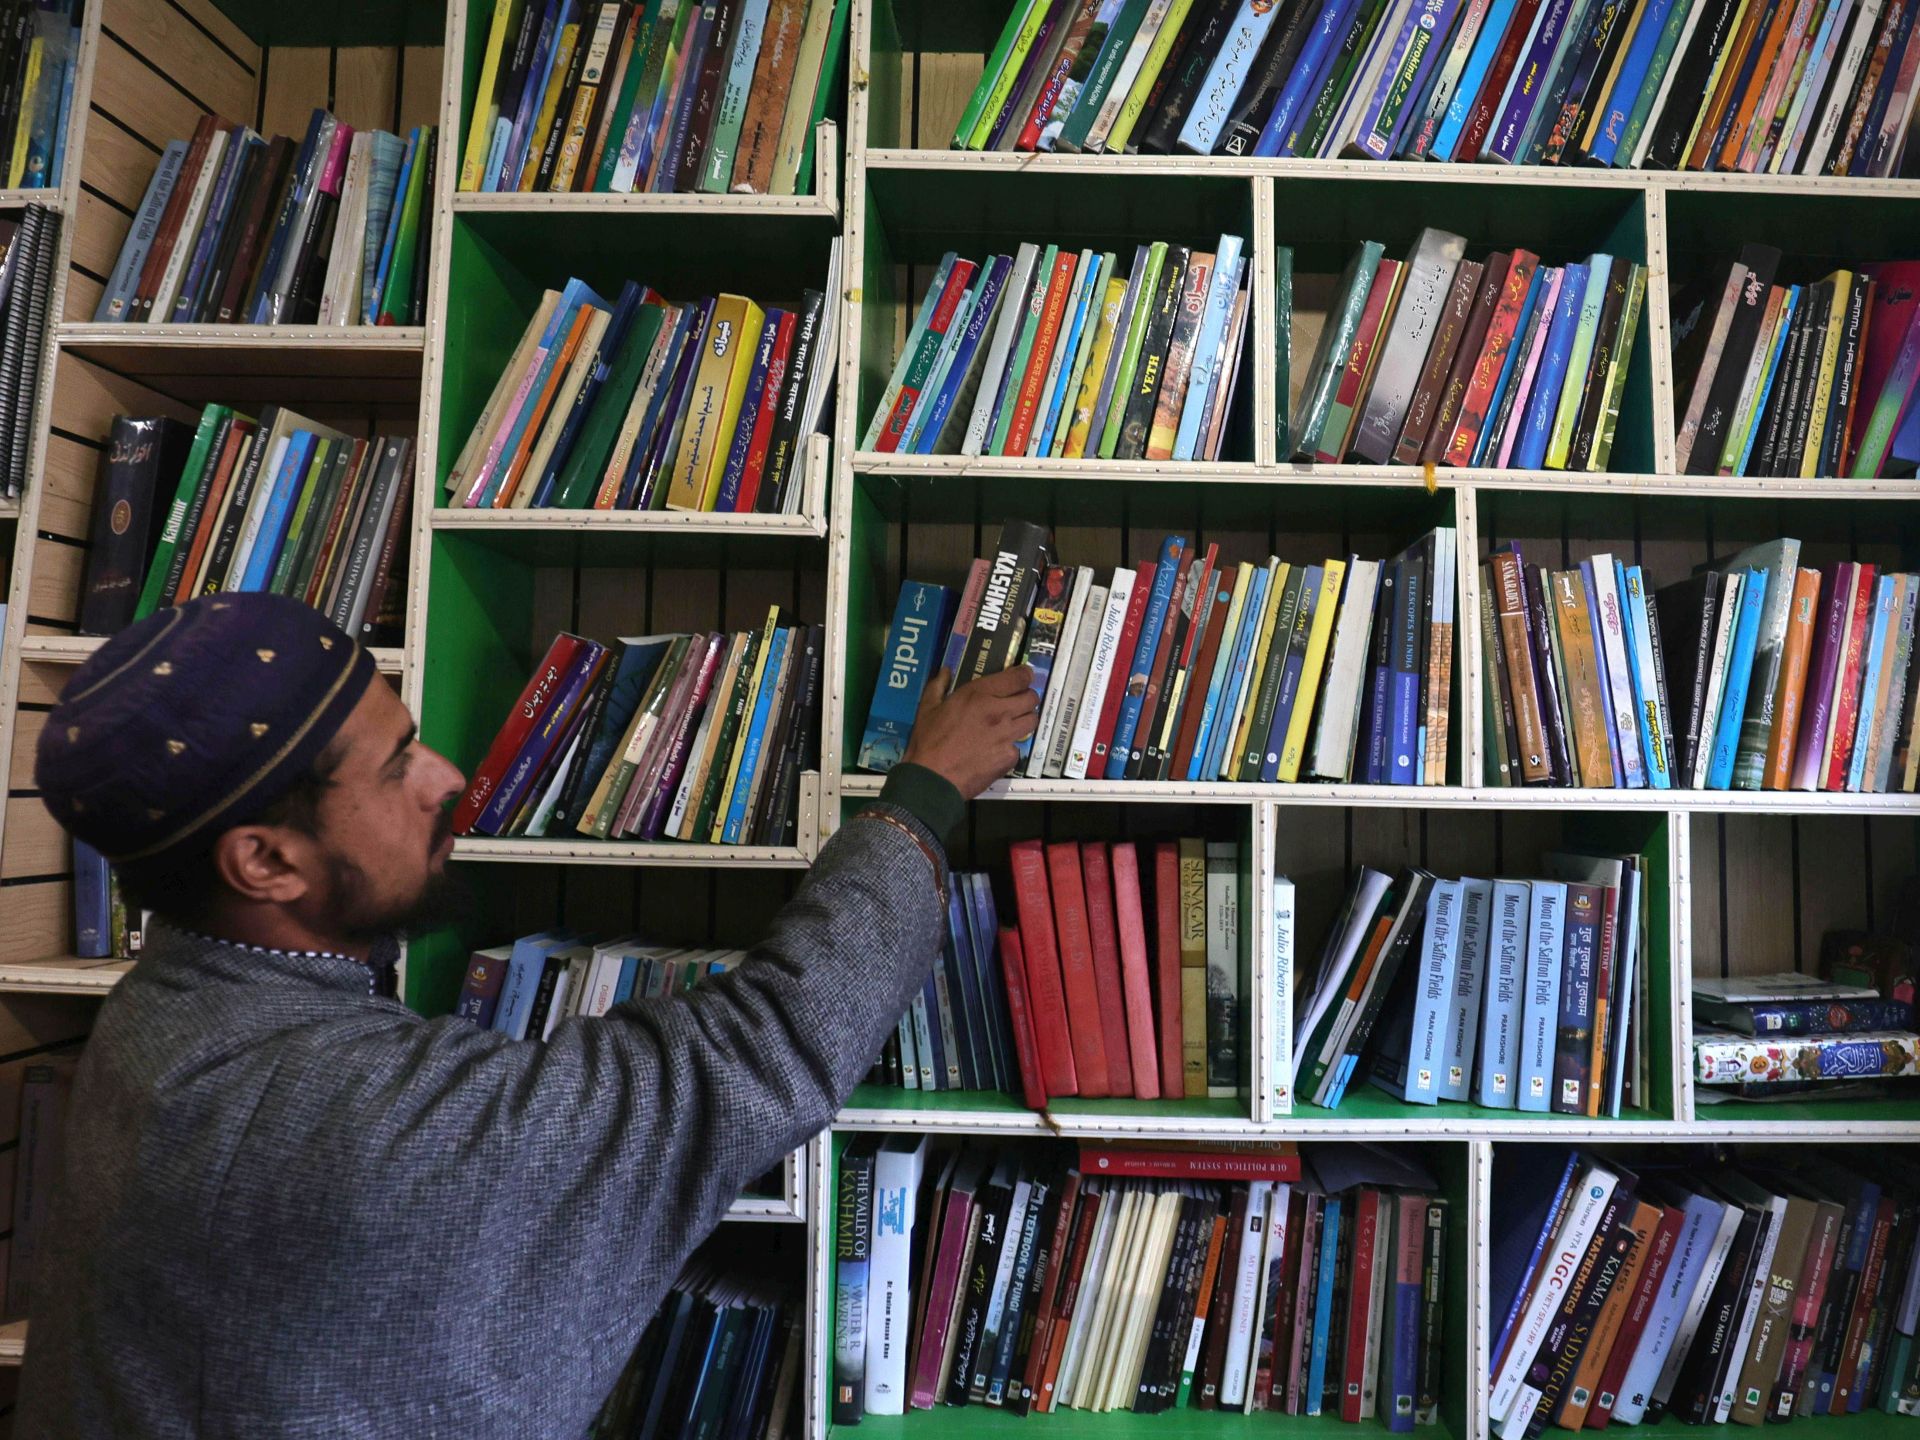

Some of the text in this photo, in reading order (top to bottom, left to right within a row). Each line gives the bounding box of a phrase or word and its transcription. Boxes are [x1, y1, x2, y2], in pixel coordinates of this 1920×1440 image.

[1086, 38, 1123, 107] The urdu magazine NAGINA
[1403, 30, 1431, 82] Nurokind
[136, 148, 181, 242] Moon of the Saffron Fields
[1836, 287, 1865, 406] JAMMU KASHMIR
[1139, 353, 1160, 396] VETH
[160, 496, 188, 544] Kashmir
[346, 536, 368, 586] RAILWAYS
[1154, 559, 1176, 599] Azad
[975, 549, 1018, 632] KASHMIR
[1000, 565, 1024, 625] THE VALLEY OF
[1278, 589, 1296, 631] CHINA
[1294, 586, 1313, 632] MIZORAM
[1104, 603, 1122, 633] Julio
[1404, 575, 1417, 668] TELESCOPES IN INDIA
[885, 614, 929, 692] India
[1094, 632, 1114, 673] Ribeiro
[674, 693, 700, 742] Examination
[660, 761, 676, 783] Easy
[667, 739, 683, 763] Made
[1190, 860, 1203, 940] SRINAGAR
[1540, 895, 1556, 920] Moon
[1427, 892, 1452, 999] Moon of the Saffron Fields
[1457, 891, 1482, 997] Moon of the Saffron Fields
[1497, 894, 1519, 1003] Moon of the Saffron Fields
[1538, 931, 1554, 946] the
[1539, 921, 1555, 931] of
[1536, 946, 1553, 978] Saffron
[1601, 946, 1609, 970] STORY
[1534, 979, 1551, 1006] Fields
[1188, 1160, 1286, 1171] OUR POLITICAL SYSTEM
[837, 1168, 855, 1257] KASHMIR
[854, 1167, 868, 1258] THE VALLEY OF
[1577, 1197, 1598, 1228] Pearson
[1603, 1204, 1617, 1224] CLASS
[1007, 1204, 1039, 1312] A TEXTBOOK OF FUNGI
[1567, 1229, 1584, 1251] NTA
[1613, 1227, 1649, 1294] Wireless
[1550, 1250, 1574, 1290] UGC
[1562, 1233, 1605, 1315] MATHEMATICS
[1586, 1253, 1621, 1310] KARMA
[836, 1283, 849, 1351] LAWRENCE
[1549, 1322, 1567, 1352] QUESTION
[1708, 1303, 1731, 1355] VED MEHTA
